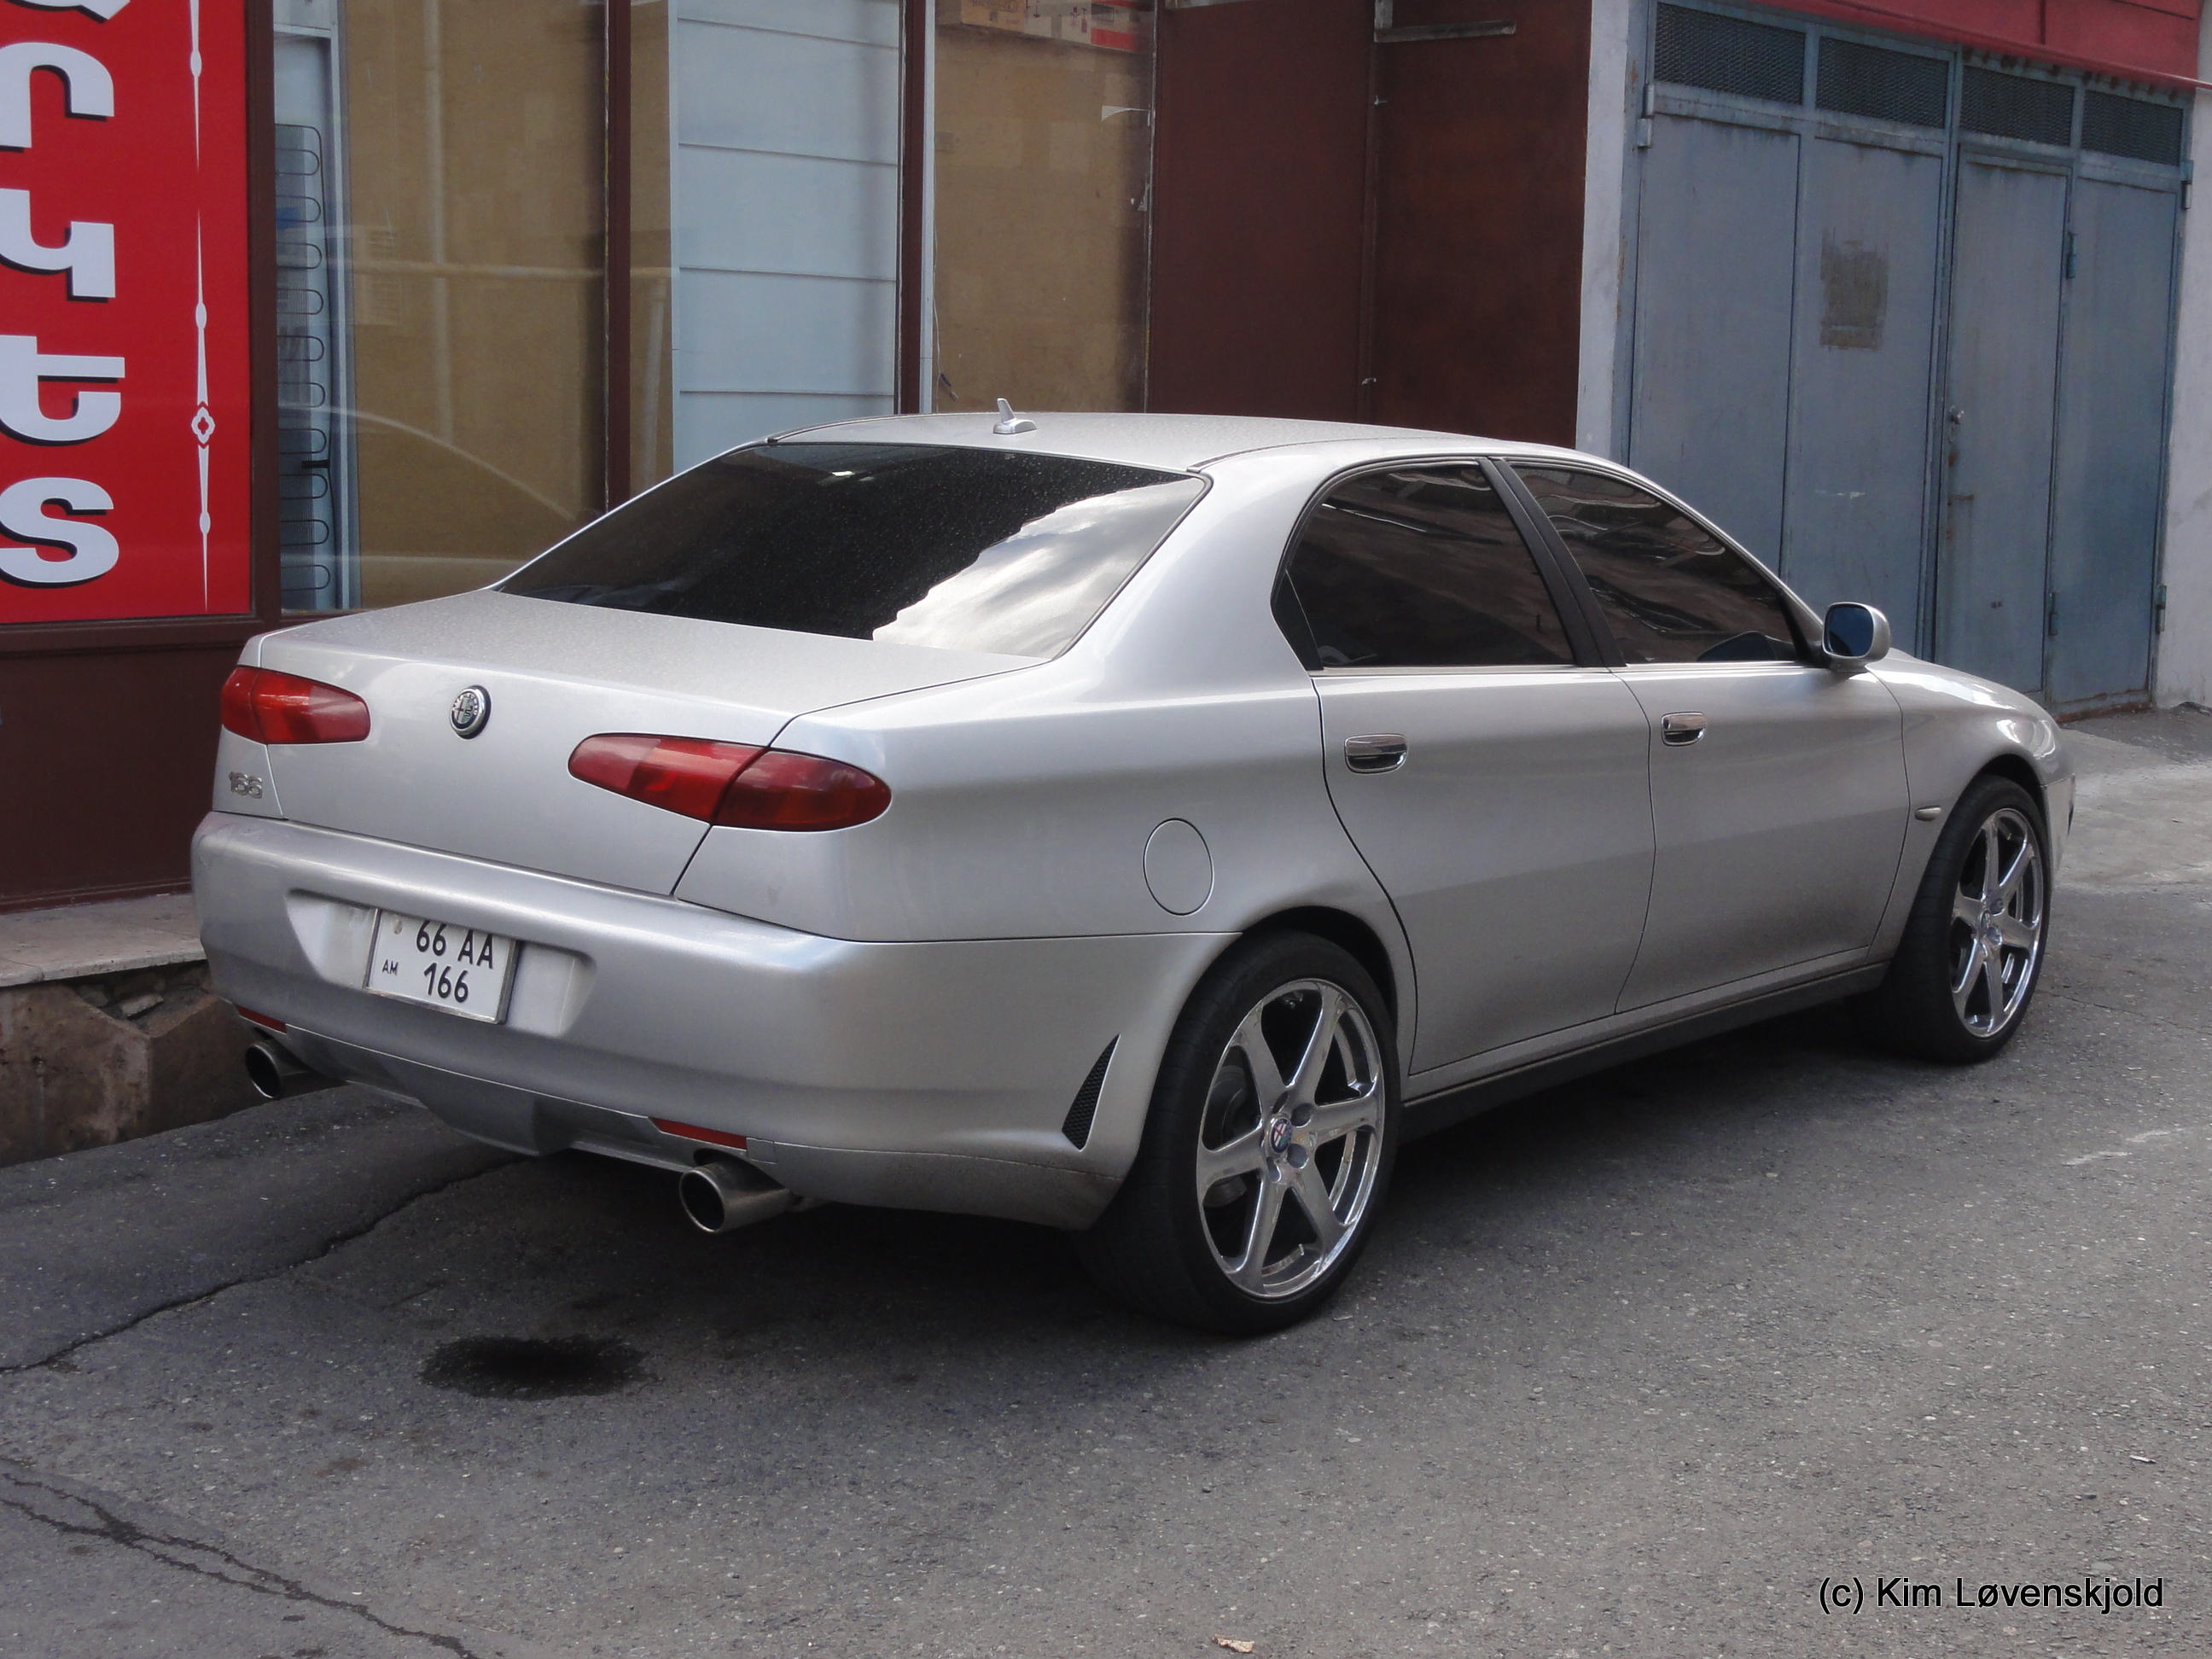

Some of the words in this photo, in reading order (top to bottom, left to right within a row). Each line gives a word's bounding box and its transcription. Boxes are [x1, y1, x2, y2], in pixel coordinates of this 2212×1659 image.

[228, 771, 263, 800] 166
[416, 919, 447, 957] 66
[457, 929, 494, 969] AA
[381, 959, 399, 975] AM
[423, 962, 469, 1004] 166
